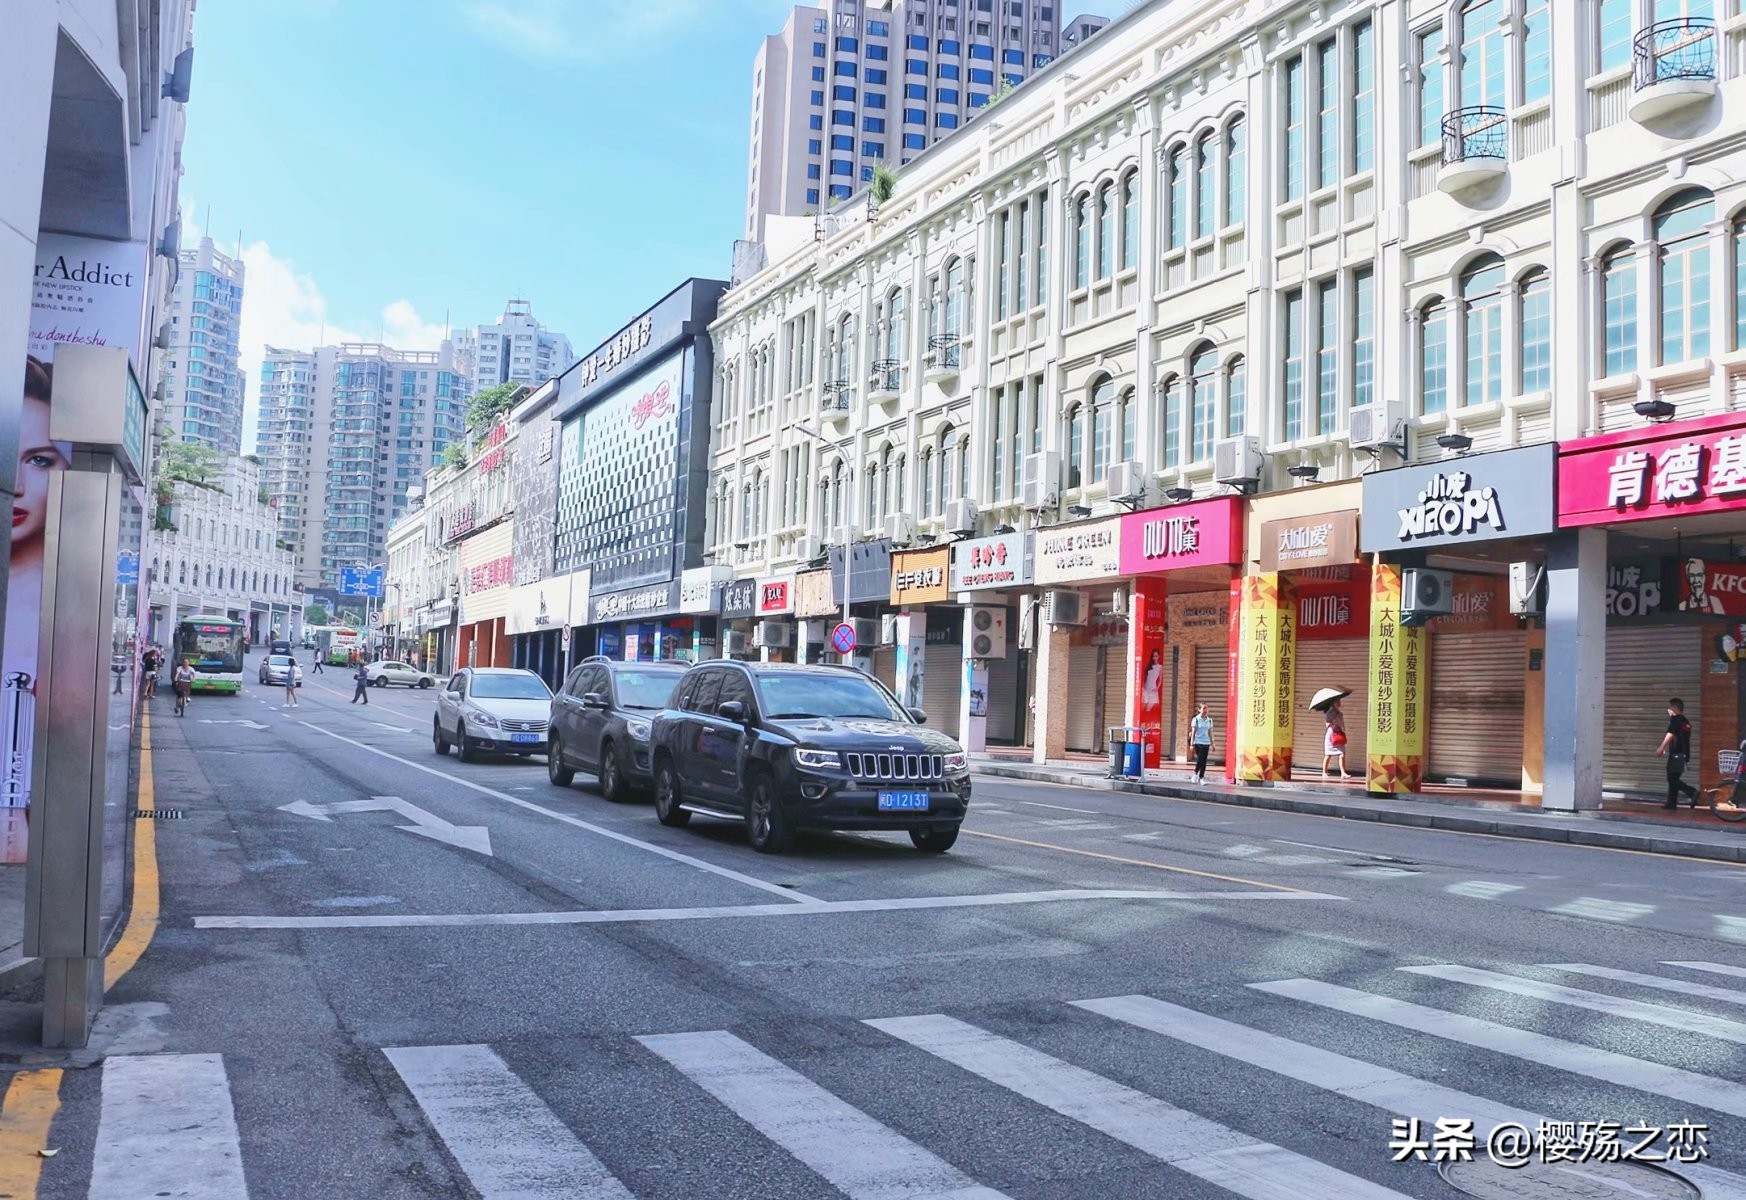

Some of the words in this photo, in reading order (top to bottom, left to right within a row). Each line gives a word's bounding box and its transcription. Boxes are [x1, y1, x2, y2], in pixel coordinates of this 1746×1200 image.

[48, 255, 134, 288] Addict
[1608, 436, 1746, 506] 肯德基
[1253, 614, 1268, 727] 大城小爱婚纱摄影
[1278, 614, 1292, 728] 大城小爱婚纱摄影
[1377, 607, 1394, 733] 大城小爱婚纱摄影
[1404, 626, 1418, 734] 城小爱婚纱摄影
[888, 744, 904, 752] Jeep
